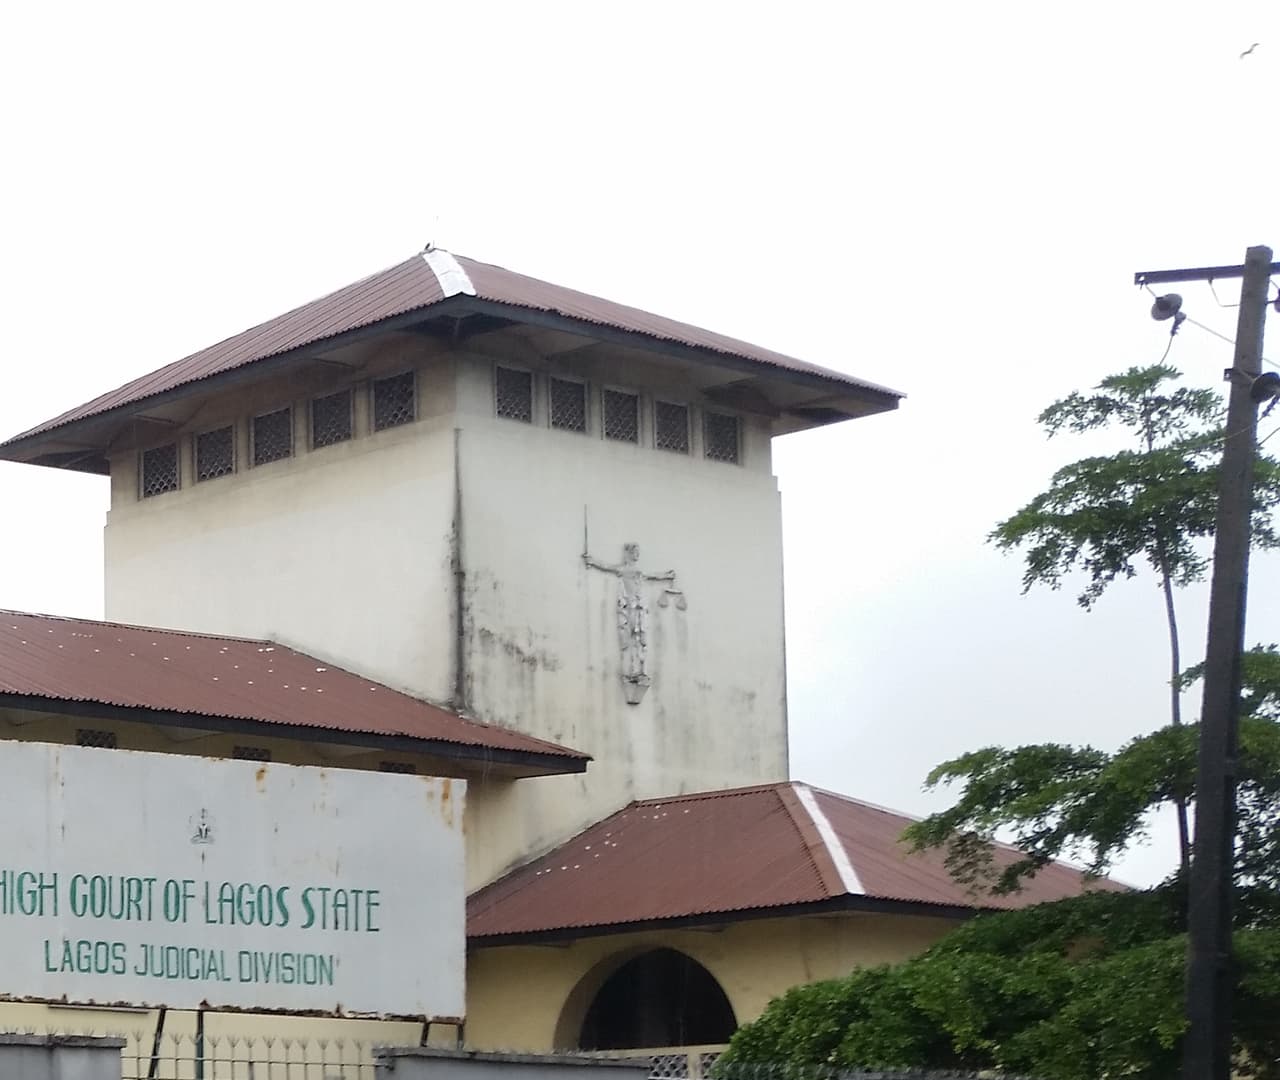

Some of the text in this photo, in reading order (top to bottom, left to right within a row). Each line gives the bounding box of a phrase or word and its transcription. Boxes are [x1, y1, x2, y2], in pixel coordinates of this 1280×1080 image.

[69, 874, 157, 924] COURT
[162, 878, 196, 923] OF
[203, 880, 291, 929] LAGOS
[299, 886, 381, 932] STATE
[43, 939, 335, 986] LAGOS JUDICIAL DIVISION
